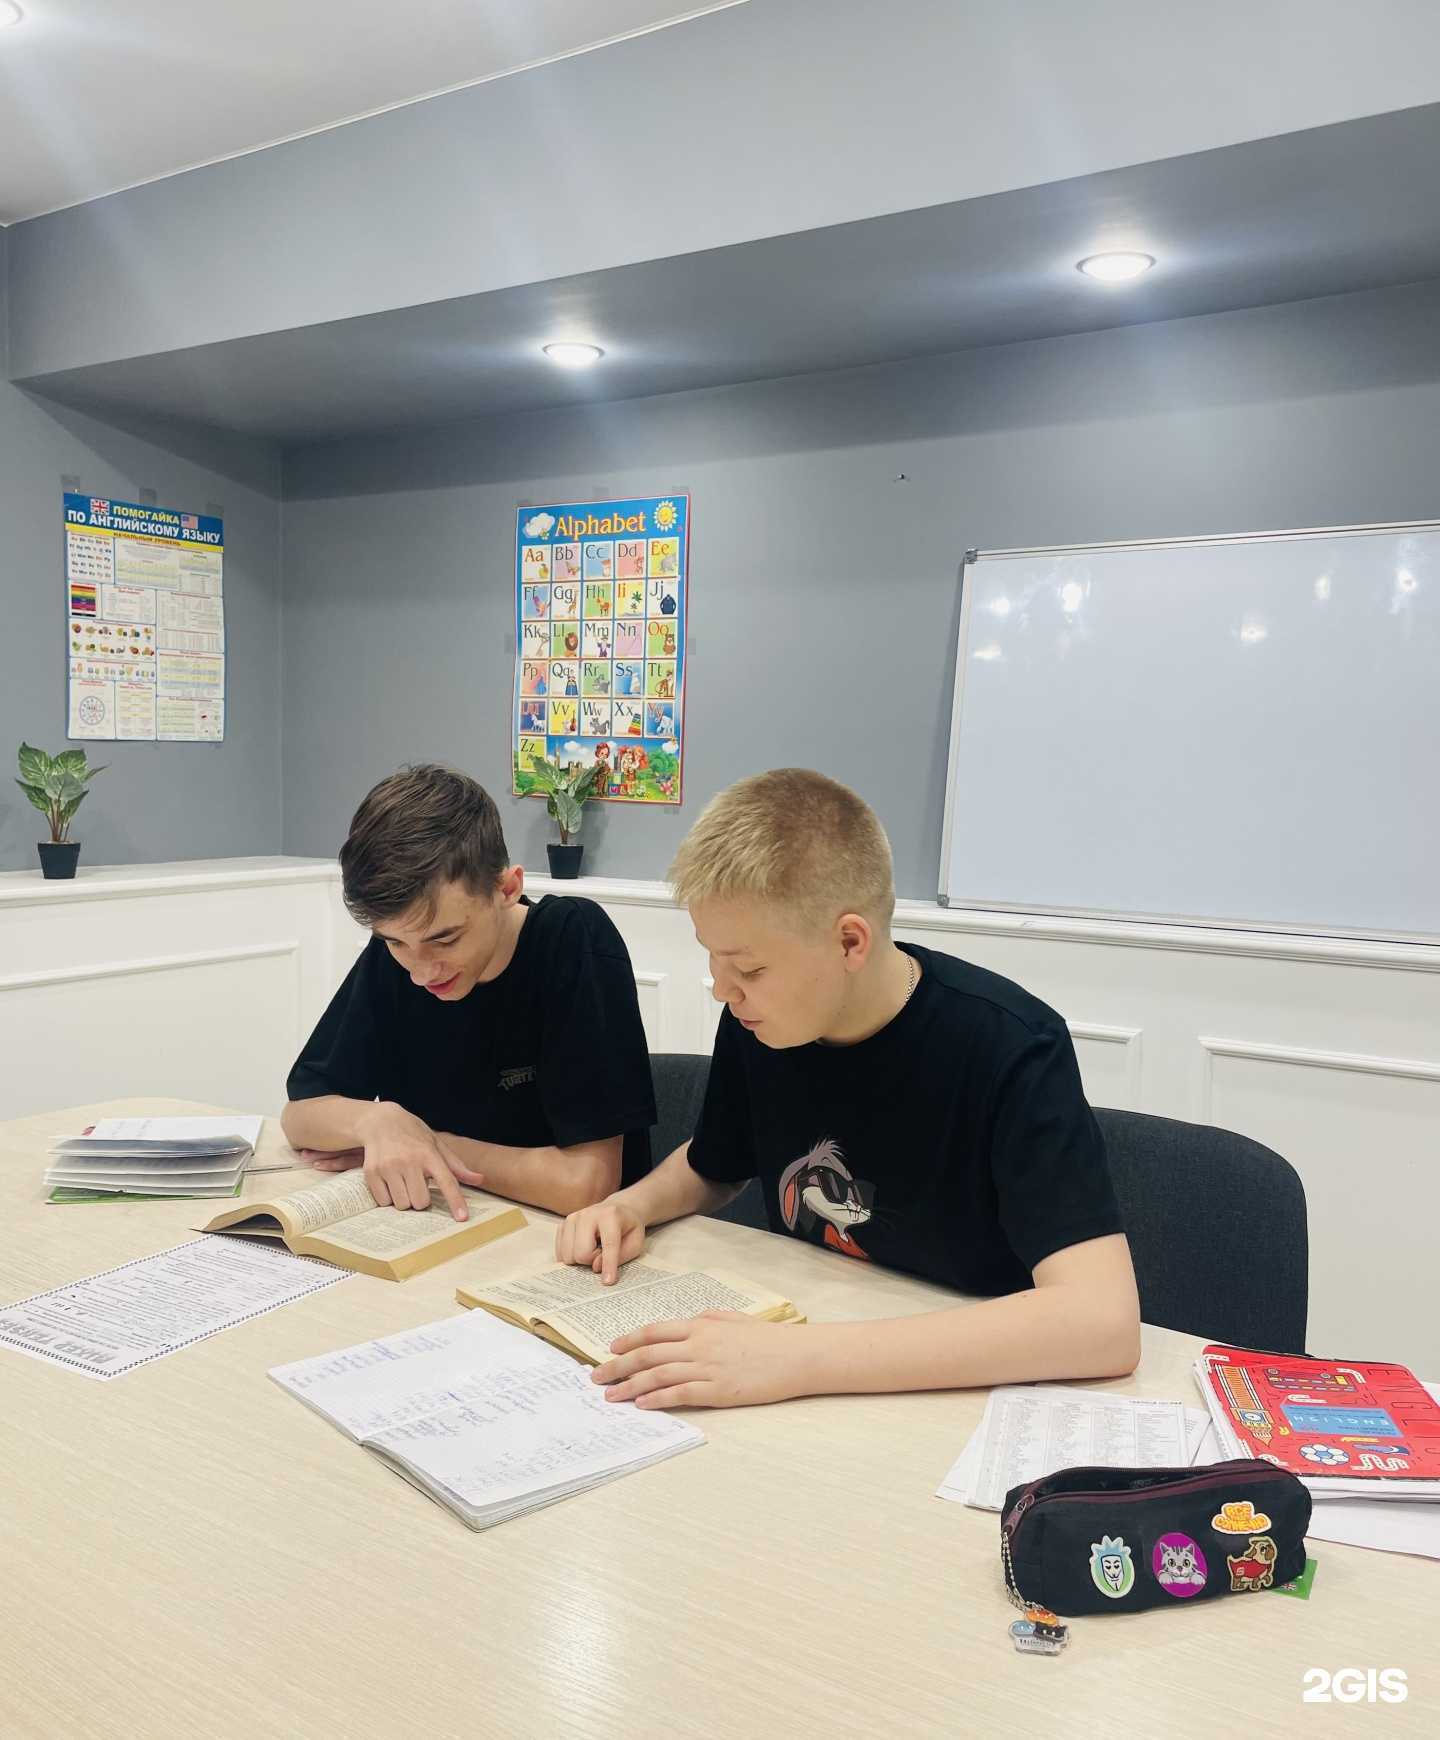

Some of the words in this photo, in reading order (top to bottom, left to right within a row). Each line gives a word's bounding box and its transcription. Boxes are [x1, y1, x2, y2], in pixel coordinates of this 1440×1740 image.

[113, 506, 179, 525] ПОМОГАЙКА
[68, 510, 86, 523] ПО
[89, 515, 179, 538] АНГЛИЙСКОМУ
[182, 528, 220, 543] ЯЗЫКУ
[555, 512, 647, 541] Alphabet
[525, 549, 544, 562] Aa
[555, 546, 573, 560] Bb
[585, 544, 606, 559] Cc
[618, 543, 637, 558] Dd
[651, 541, 670, 556] Ee
[524, 586, 537, 600] Ff
[554, 586, 573, 604] Gg
[586, 584, 605, 599] Hh
[617, 583, 626, 598] Ii
[650, 580, 664, 600] Jj
[524, 624, 541, 638] Kk
[553, 623, 565, 637] Ll
[584, 624, 609, 638] Mm
[617, 623, 636, 638] Nn
[648, 621, 669, 636] Oo
[523, 663, 537, 681] Pp
[552, 662, 570, 678] Qq
[584, 663, 600, 676] Rr
[615, 662, 632, 676] Ss
[648, 662, 662, 677] Tt
[552, 701, 569, 715] Vv
[582, 702, 602, 716] Ww
[615, 702, 633, 716] Xx
[520, 738, 535, 753] Zz
[1293, 1414, 1390, 1426] ENGLISH
